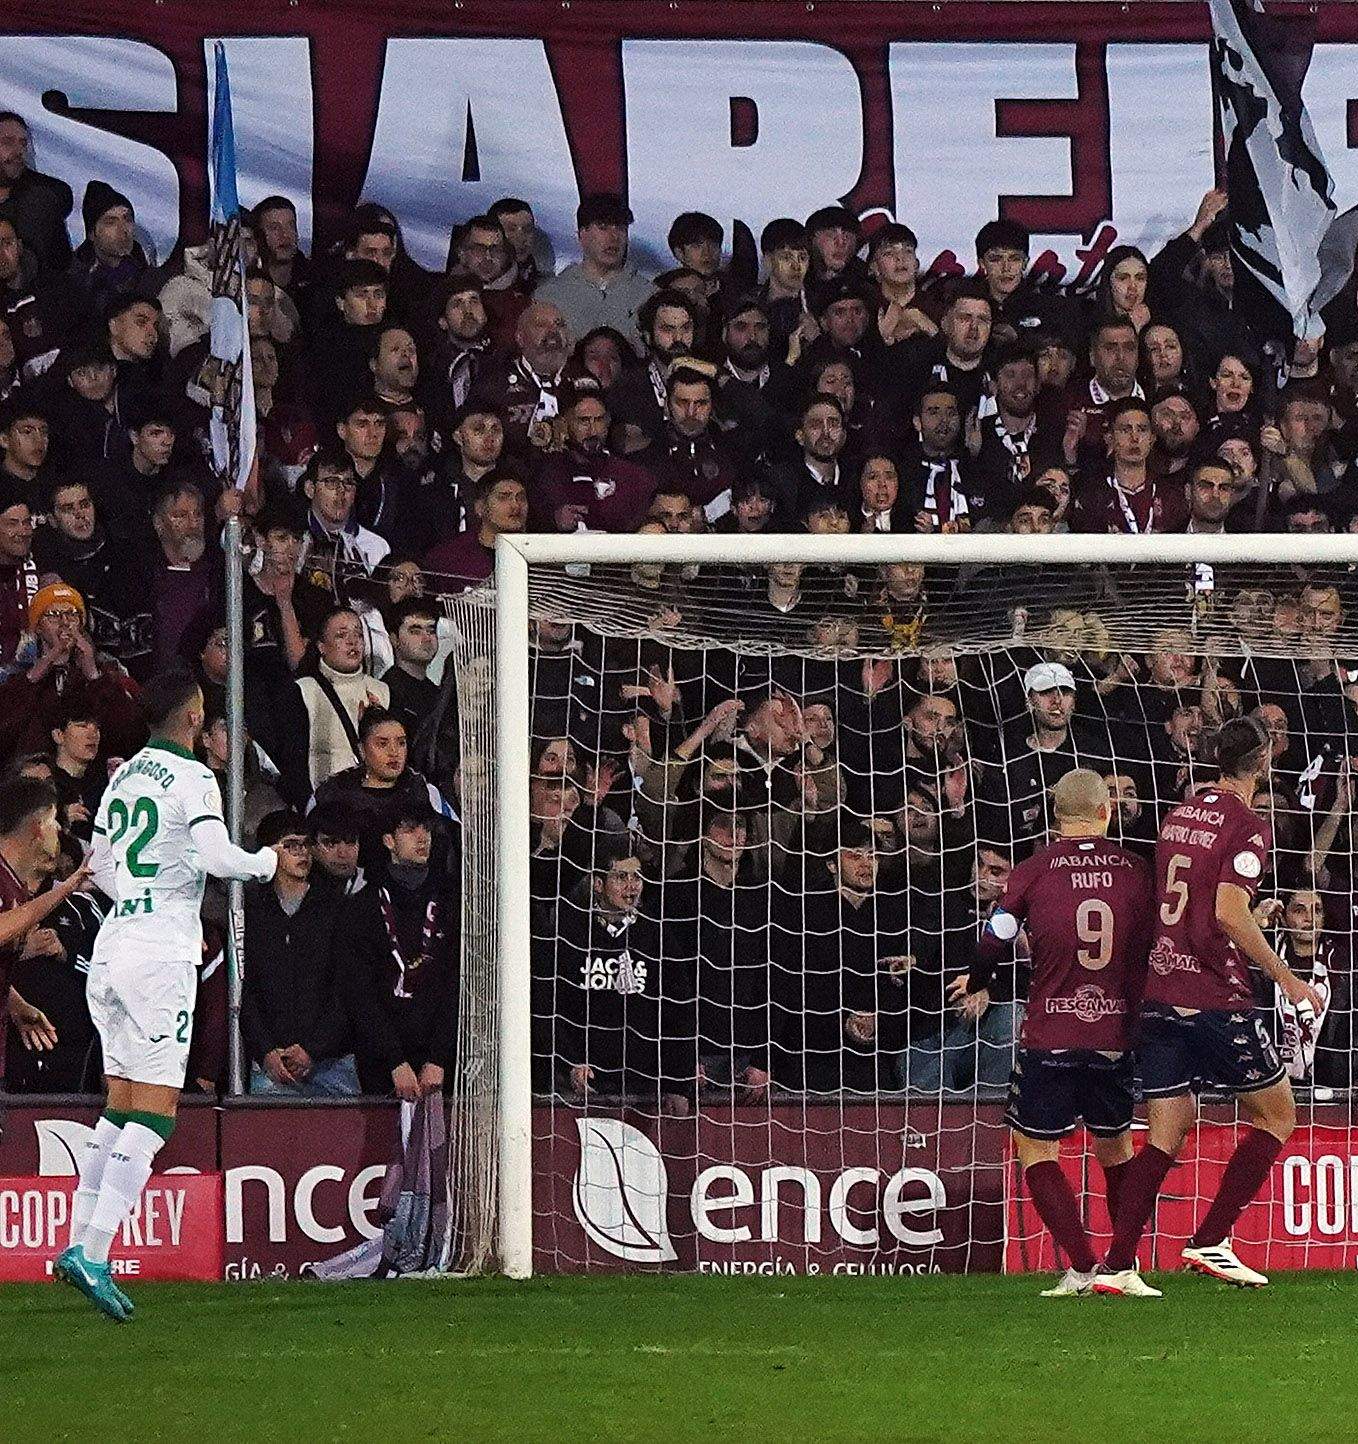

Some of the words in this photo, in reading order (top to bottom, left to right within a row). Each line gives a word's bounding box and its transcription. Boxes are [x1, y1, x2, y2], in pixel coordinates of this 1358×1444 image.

[108, 797, 160, 877] 22
[1071, 871, 1113, 890] RUFO
[1159, 853, 1192, 926] 5
[580, 957, 634, 975] JAC
[1076, 899, 1114, 971] 9
[580, 973, 646, 994] JONS
[0, 1190, 68, 1248] COP
[225, 1164, 388, 1243] nce
[690, 1165, 946, 1246] ence
